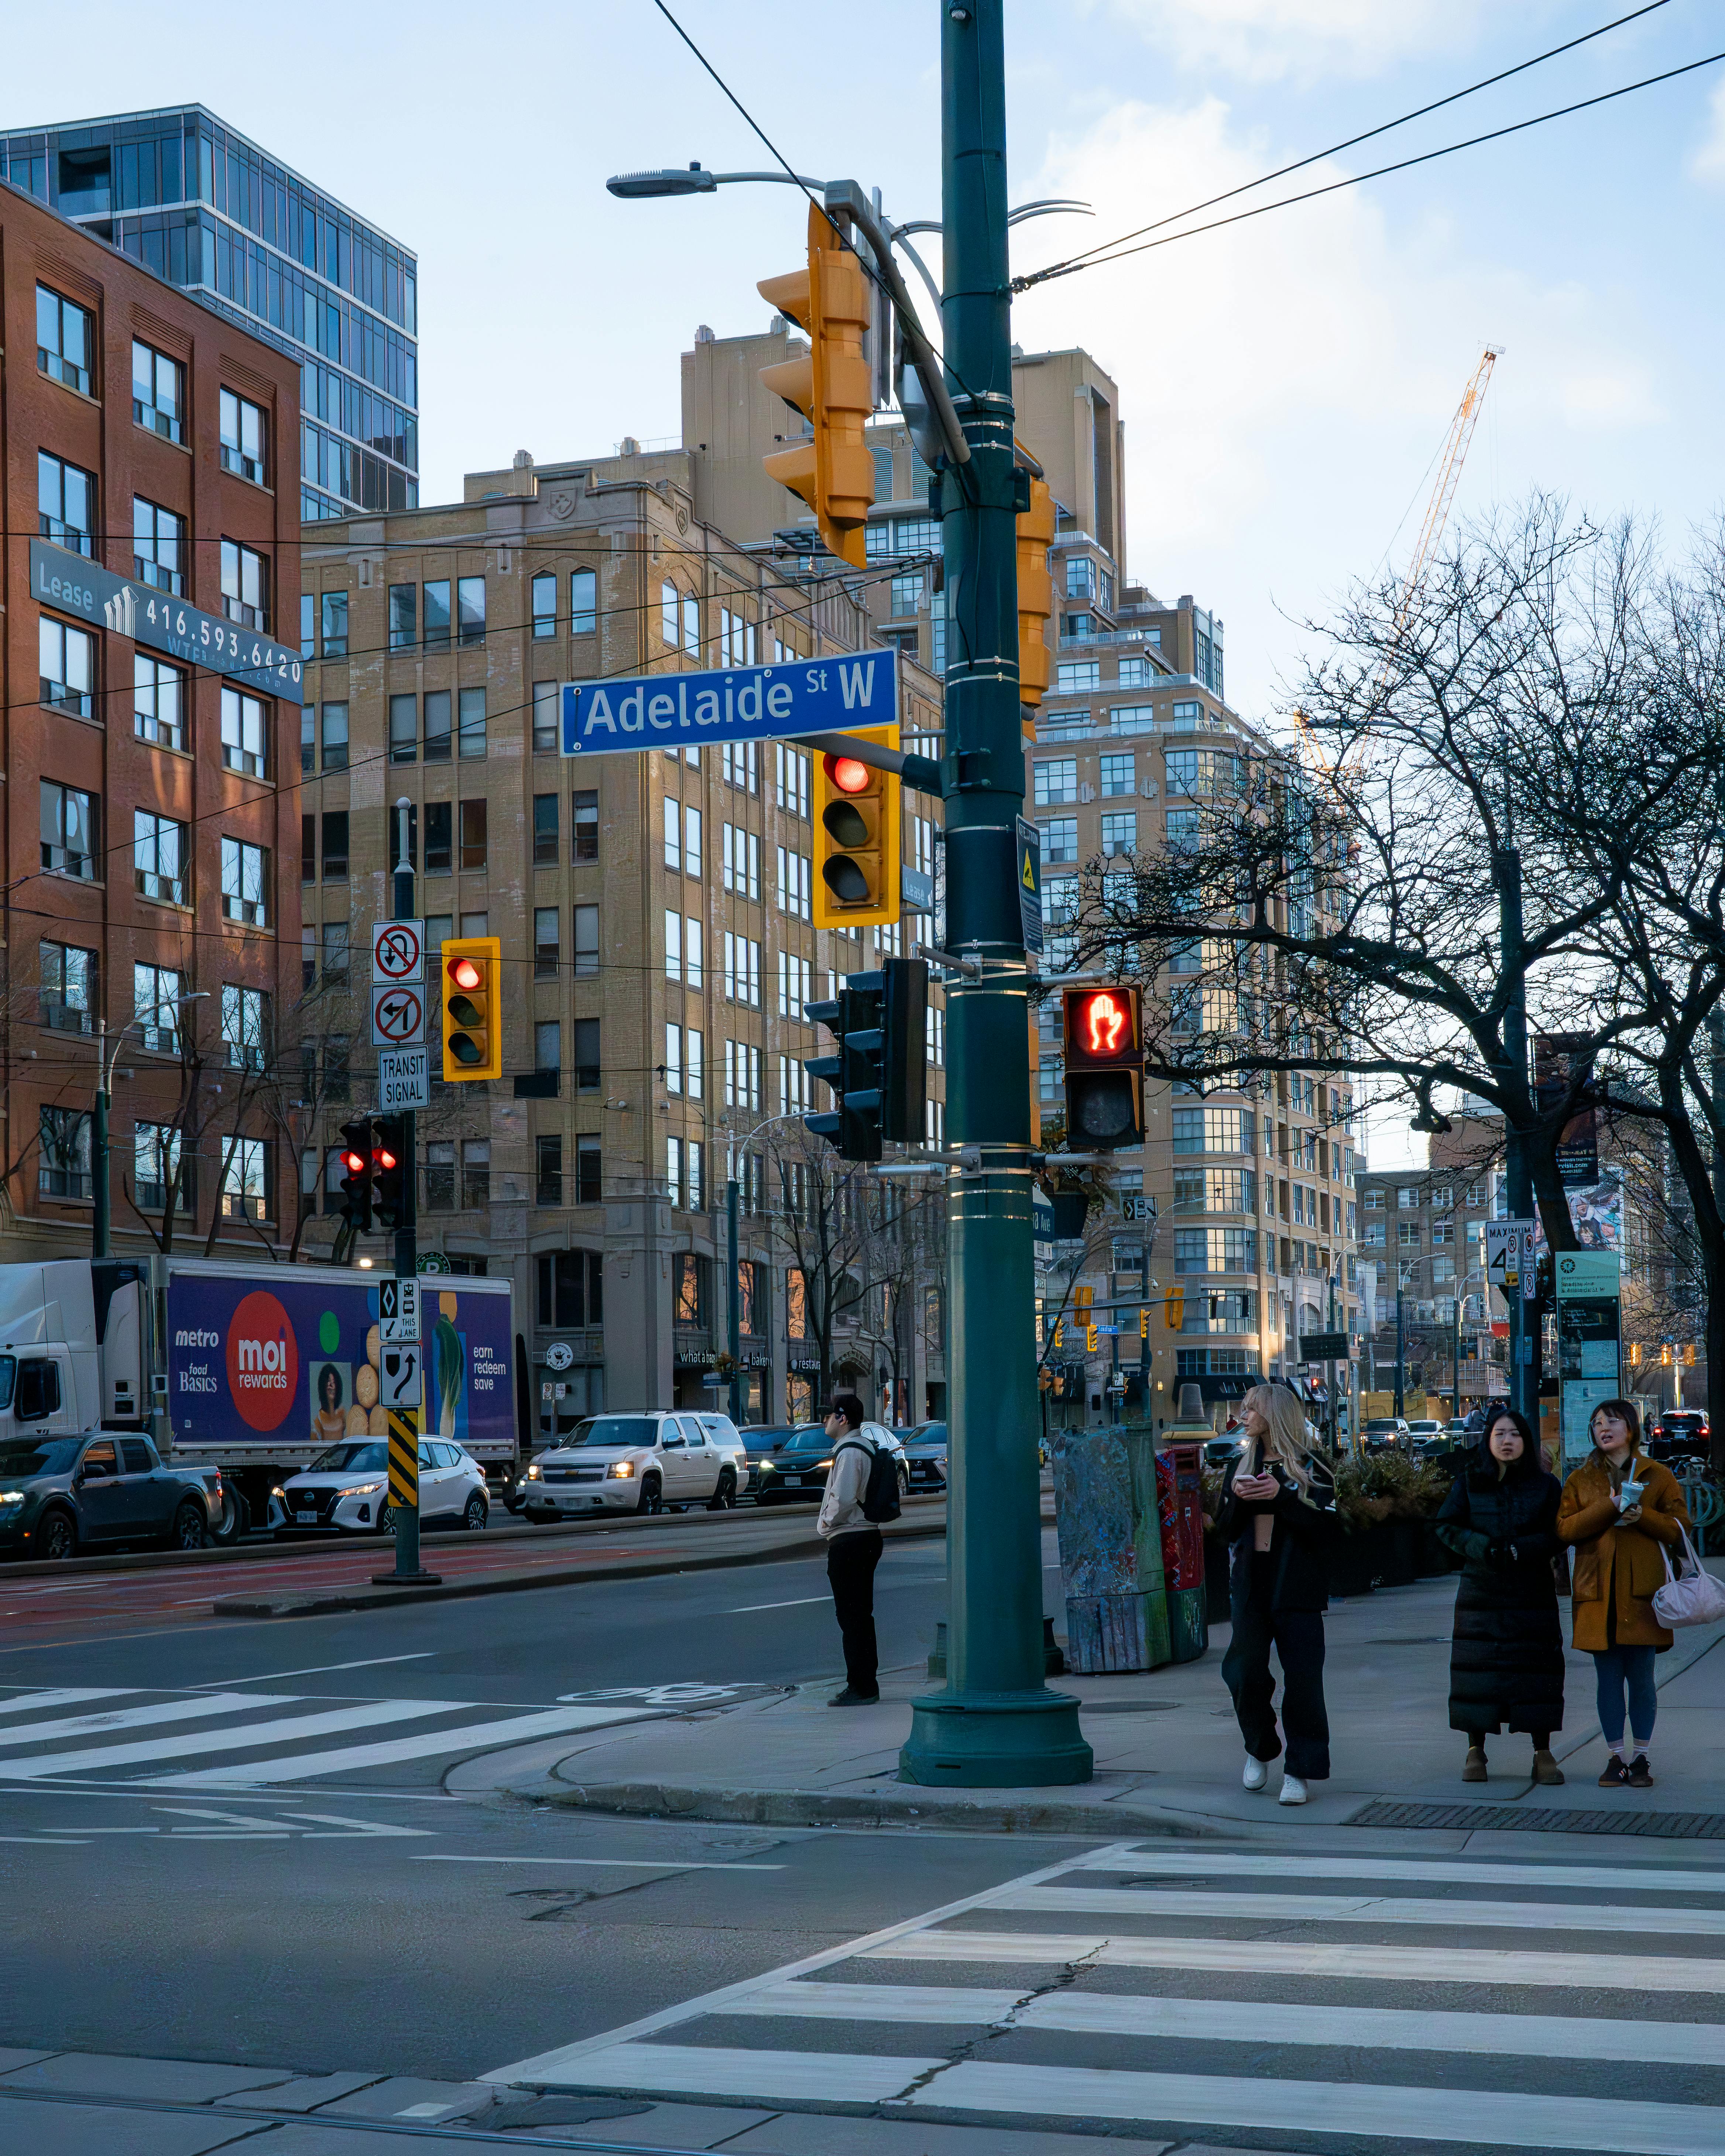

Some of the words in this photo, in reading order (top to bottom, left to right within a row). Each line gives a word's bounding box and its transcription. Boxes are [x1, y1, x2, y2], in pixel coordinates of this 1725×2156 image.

[40, 562, 93, 611] Lease
[147, 599, 301, 683] 416.593.6420
[584, 674, 793, 735] Adelaide
[806, 669, 827, 693] St
[839, 660, 875, 709] W
[383, 1055, 424, 1078] TRANSIT
[386, 1080, 422, 1103] SIGNAL
[175, 1329, 219, 1347] metro
[400, 1328, 416, 1337] LANE
[239, 1333, 286, 1371] moi
[474, 1346, 493, 1359] earn
[680, 1349, 701, 1363] what
[702, 1353, 705, 1363] a
[752, 1352, 771, 1369] bakery
[799, 1358, 820, 1370] restaura
[189, 1363, 208, 1375] food
[474, 1362, 506, 1375] redeem
[239, 1371, 287, 1389] rewards
[474, 1379, 493, 1390] save
